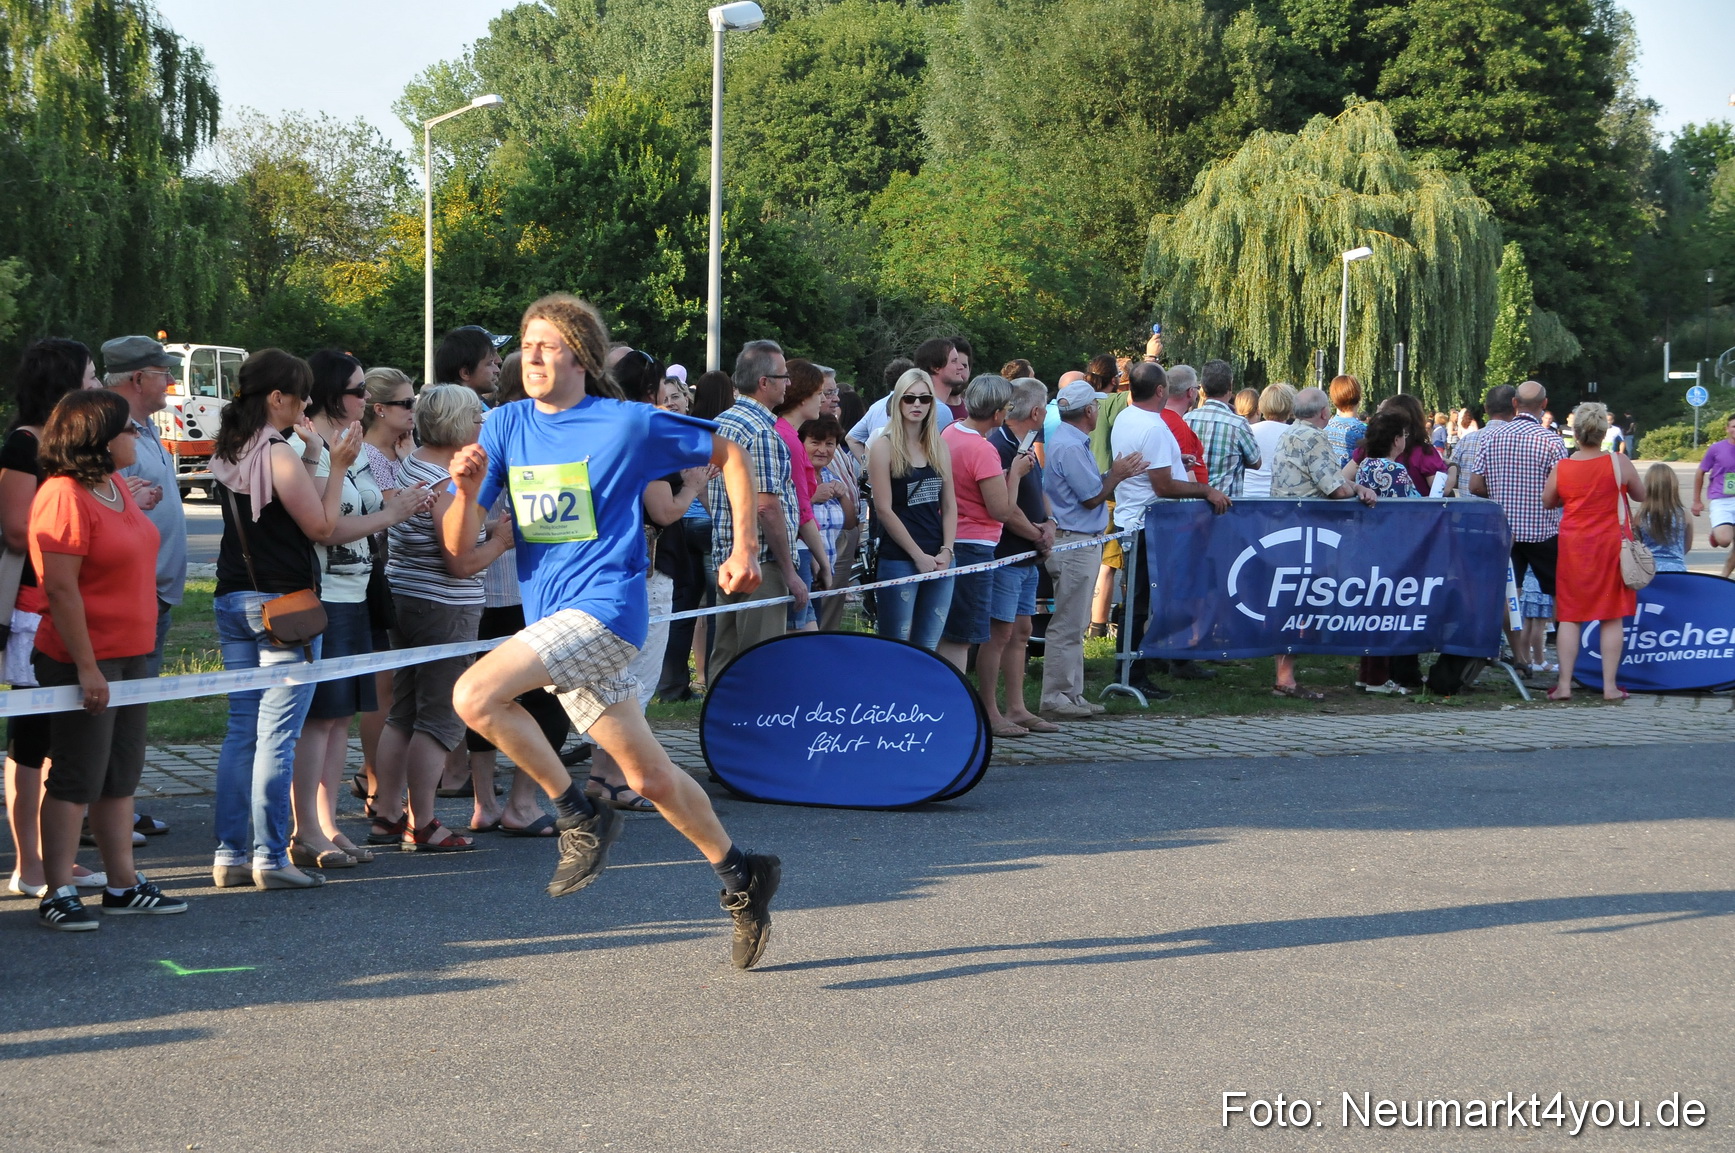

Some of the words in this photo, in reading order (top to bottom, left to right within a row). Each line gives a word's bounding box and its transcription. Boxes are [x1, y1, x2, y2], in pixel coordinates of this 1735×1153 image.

[522, 491, 580, 524] 702
[1267, 565, 1444, 608] Fischer
[1281, 614, 1427, 632] AUTOMOBILE
[1621, 648, 1735, 665] AUTOMOBILE
[756, 705, 799, 728] und
[805, 701, 845, 725] das
[850, 702, 944, 725] Lächeln
[807, 731, 870, 761] fährt
[876, 732, 933, 753] mit!
